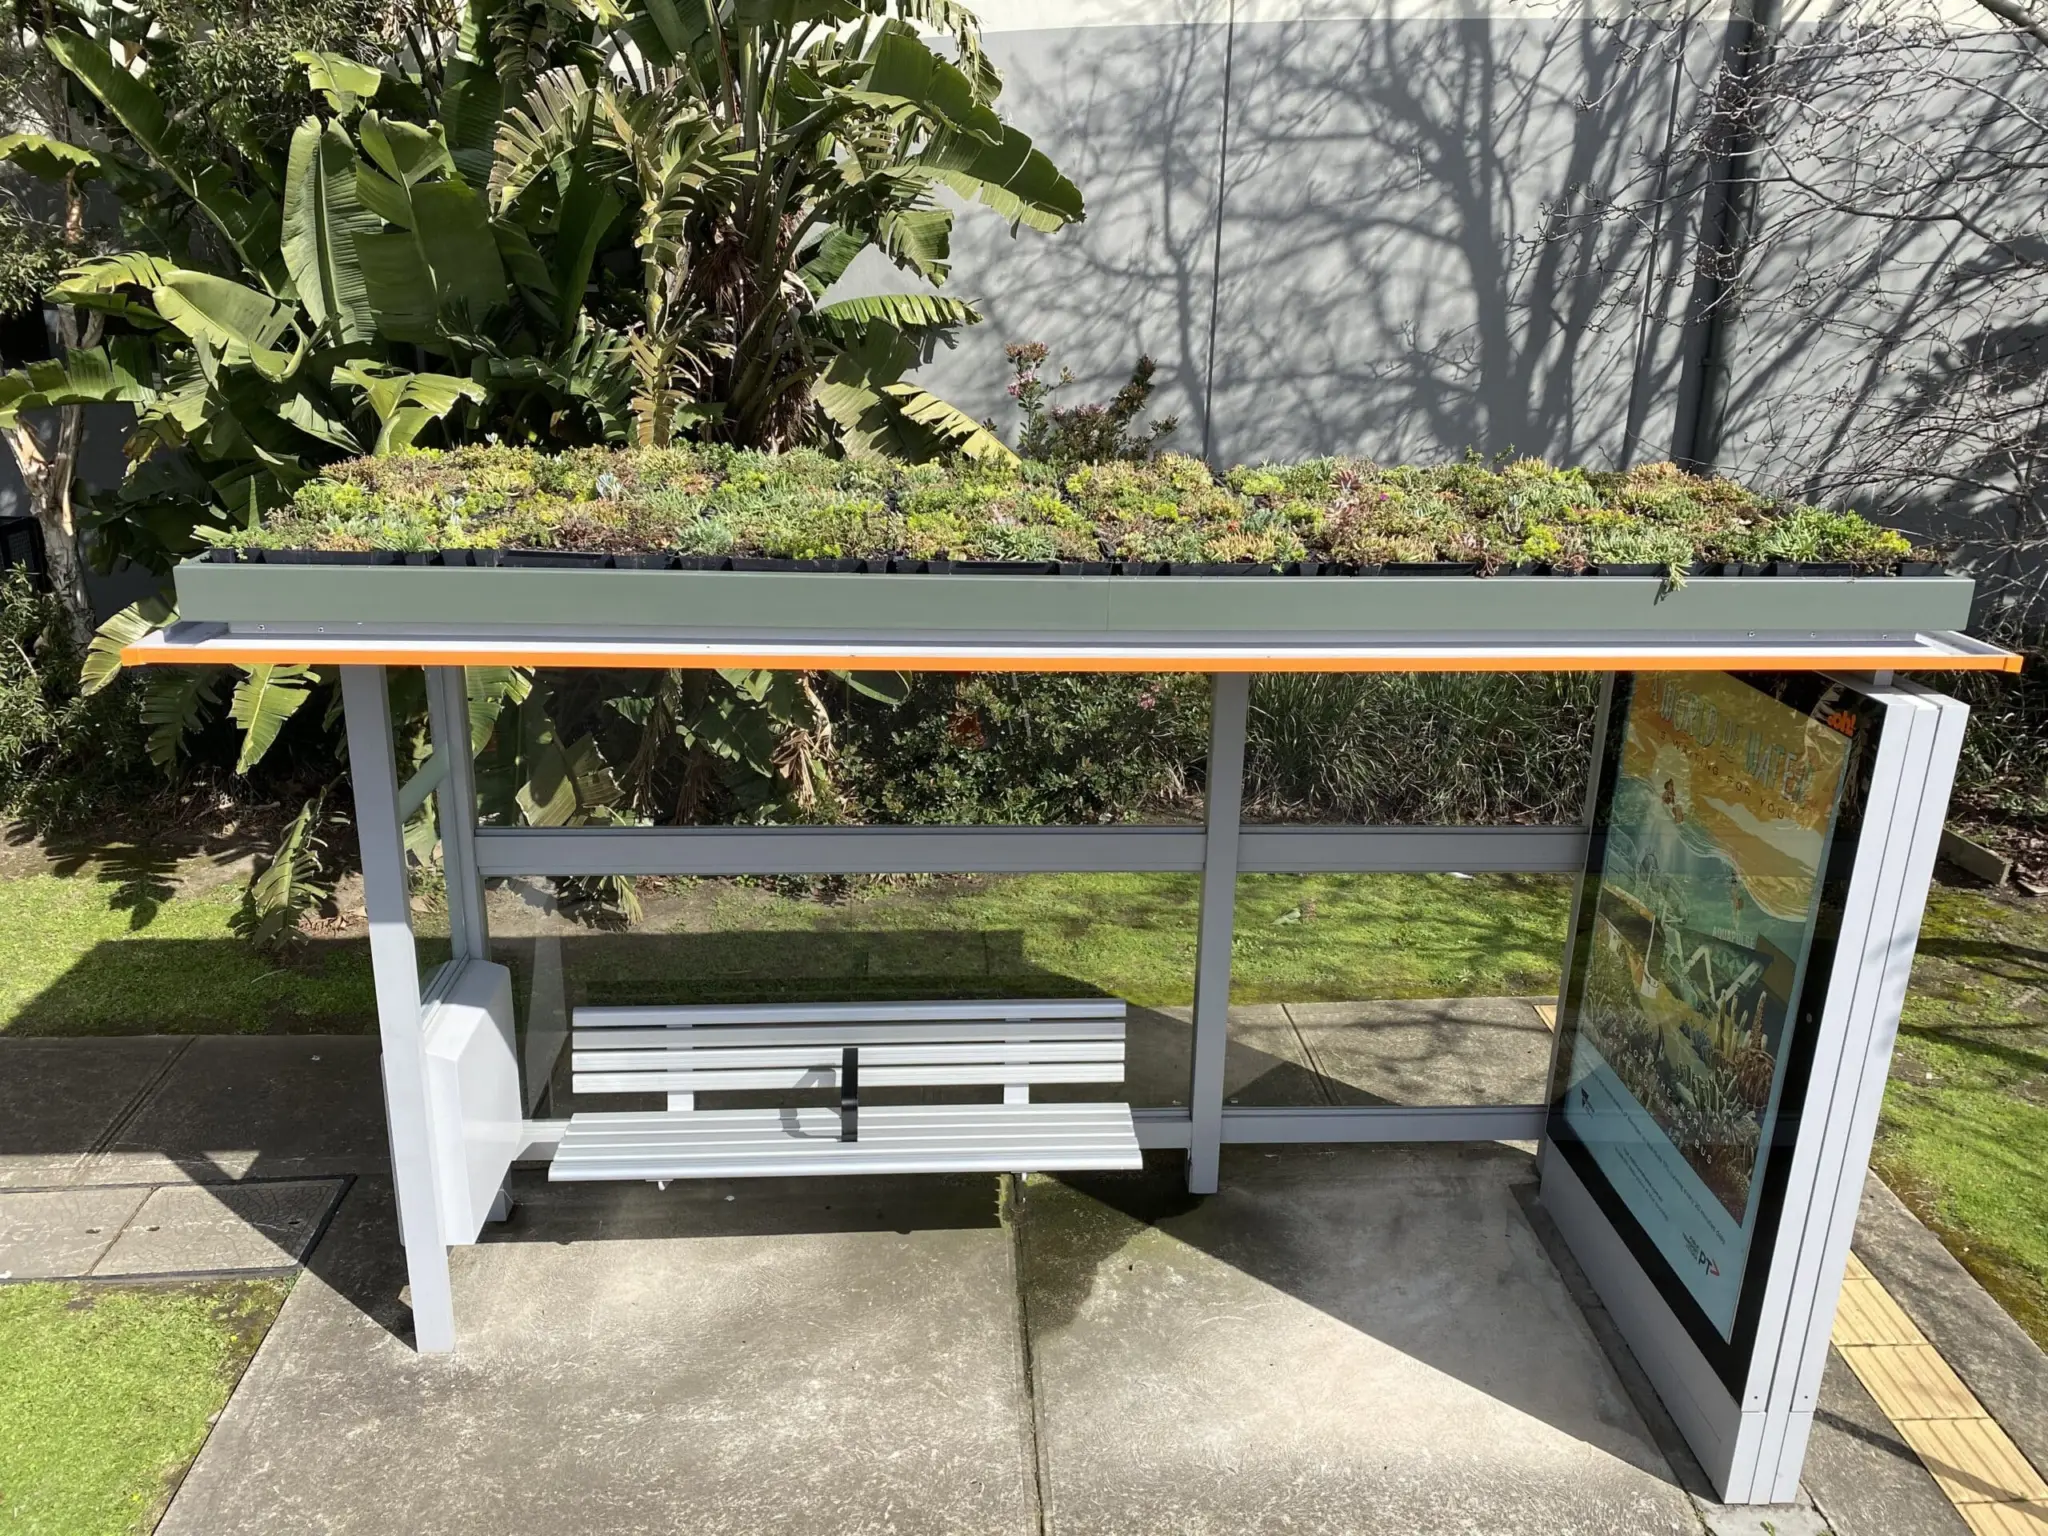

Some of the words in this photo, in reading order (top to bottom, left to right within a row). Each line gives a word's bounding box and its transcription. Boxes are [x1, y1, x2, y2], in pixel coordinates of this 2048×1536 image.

[1660, 679, 1717, 748] WORLD
[1726, 775, 1751, 797] FOR
[1760, 798, 1785, 820] YOU
[1656, 1073, 1672, 1098] THE
[1680, 1102, 1711, 1142] WORLD
[1694, 1138, 1712, 1164] BUS
